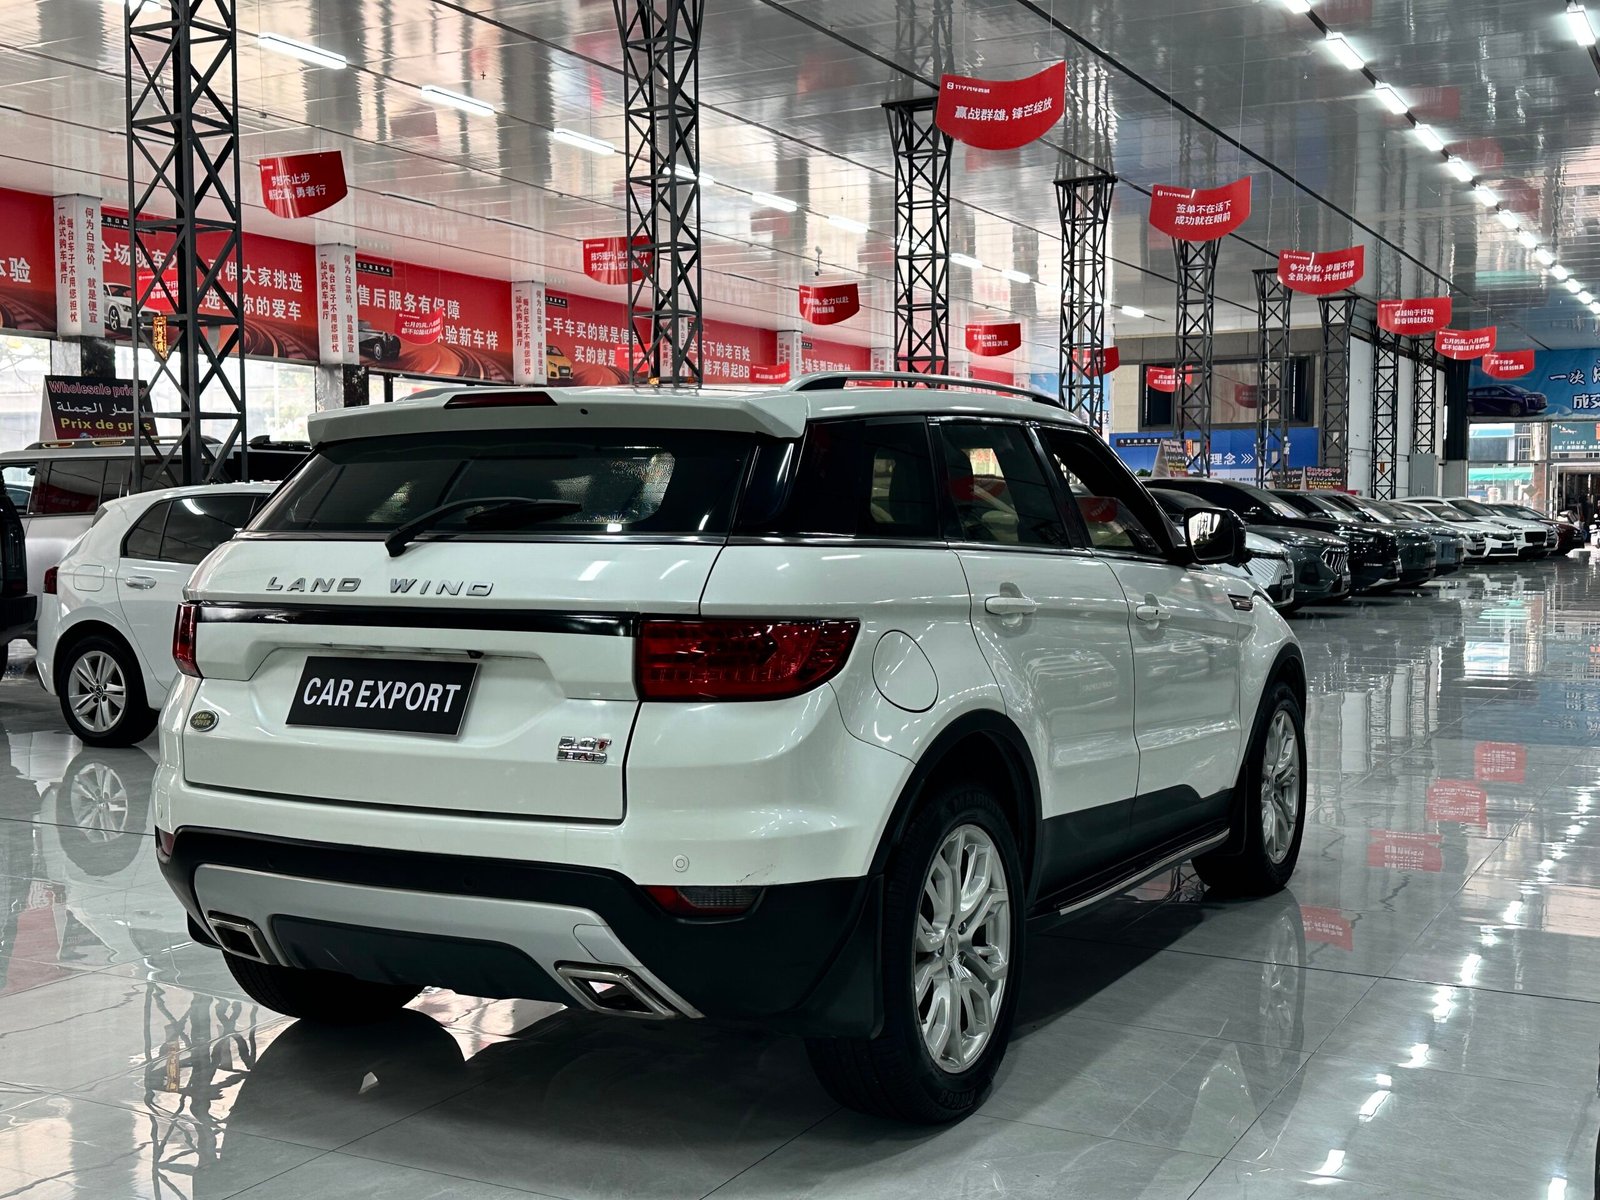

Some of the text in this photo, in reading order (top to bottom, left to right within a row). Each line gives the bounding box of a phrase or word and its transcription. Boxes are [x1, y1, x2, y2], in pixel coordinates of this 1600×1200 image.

[1176, 200, 1231, 214] 签单不在话下
[1174, 211, 1231, 226] 成功就在眼前
[358, 284, 460, 320] 售后服务有保障
[695, 357, 750, 379] 能开得起BB
[1550, 370, 1585, 385] 一次
[48, 381, 112, 396] Wholesale
[60, 417, 152, 432] Prix de grs
[266, 577, 494, 597] LAND WIND
[303, 677, 461, 713] CAR EXPORT
